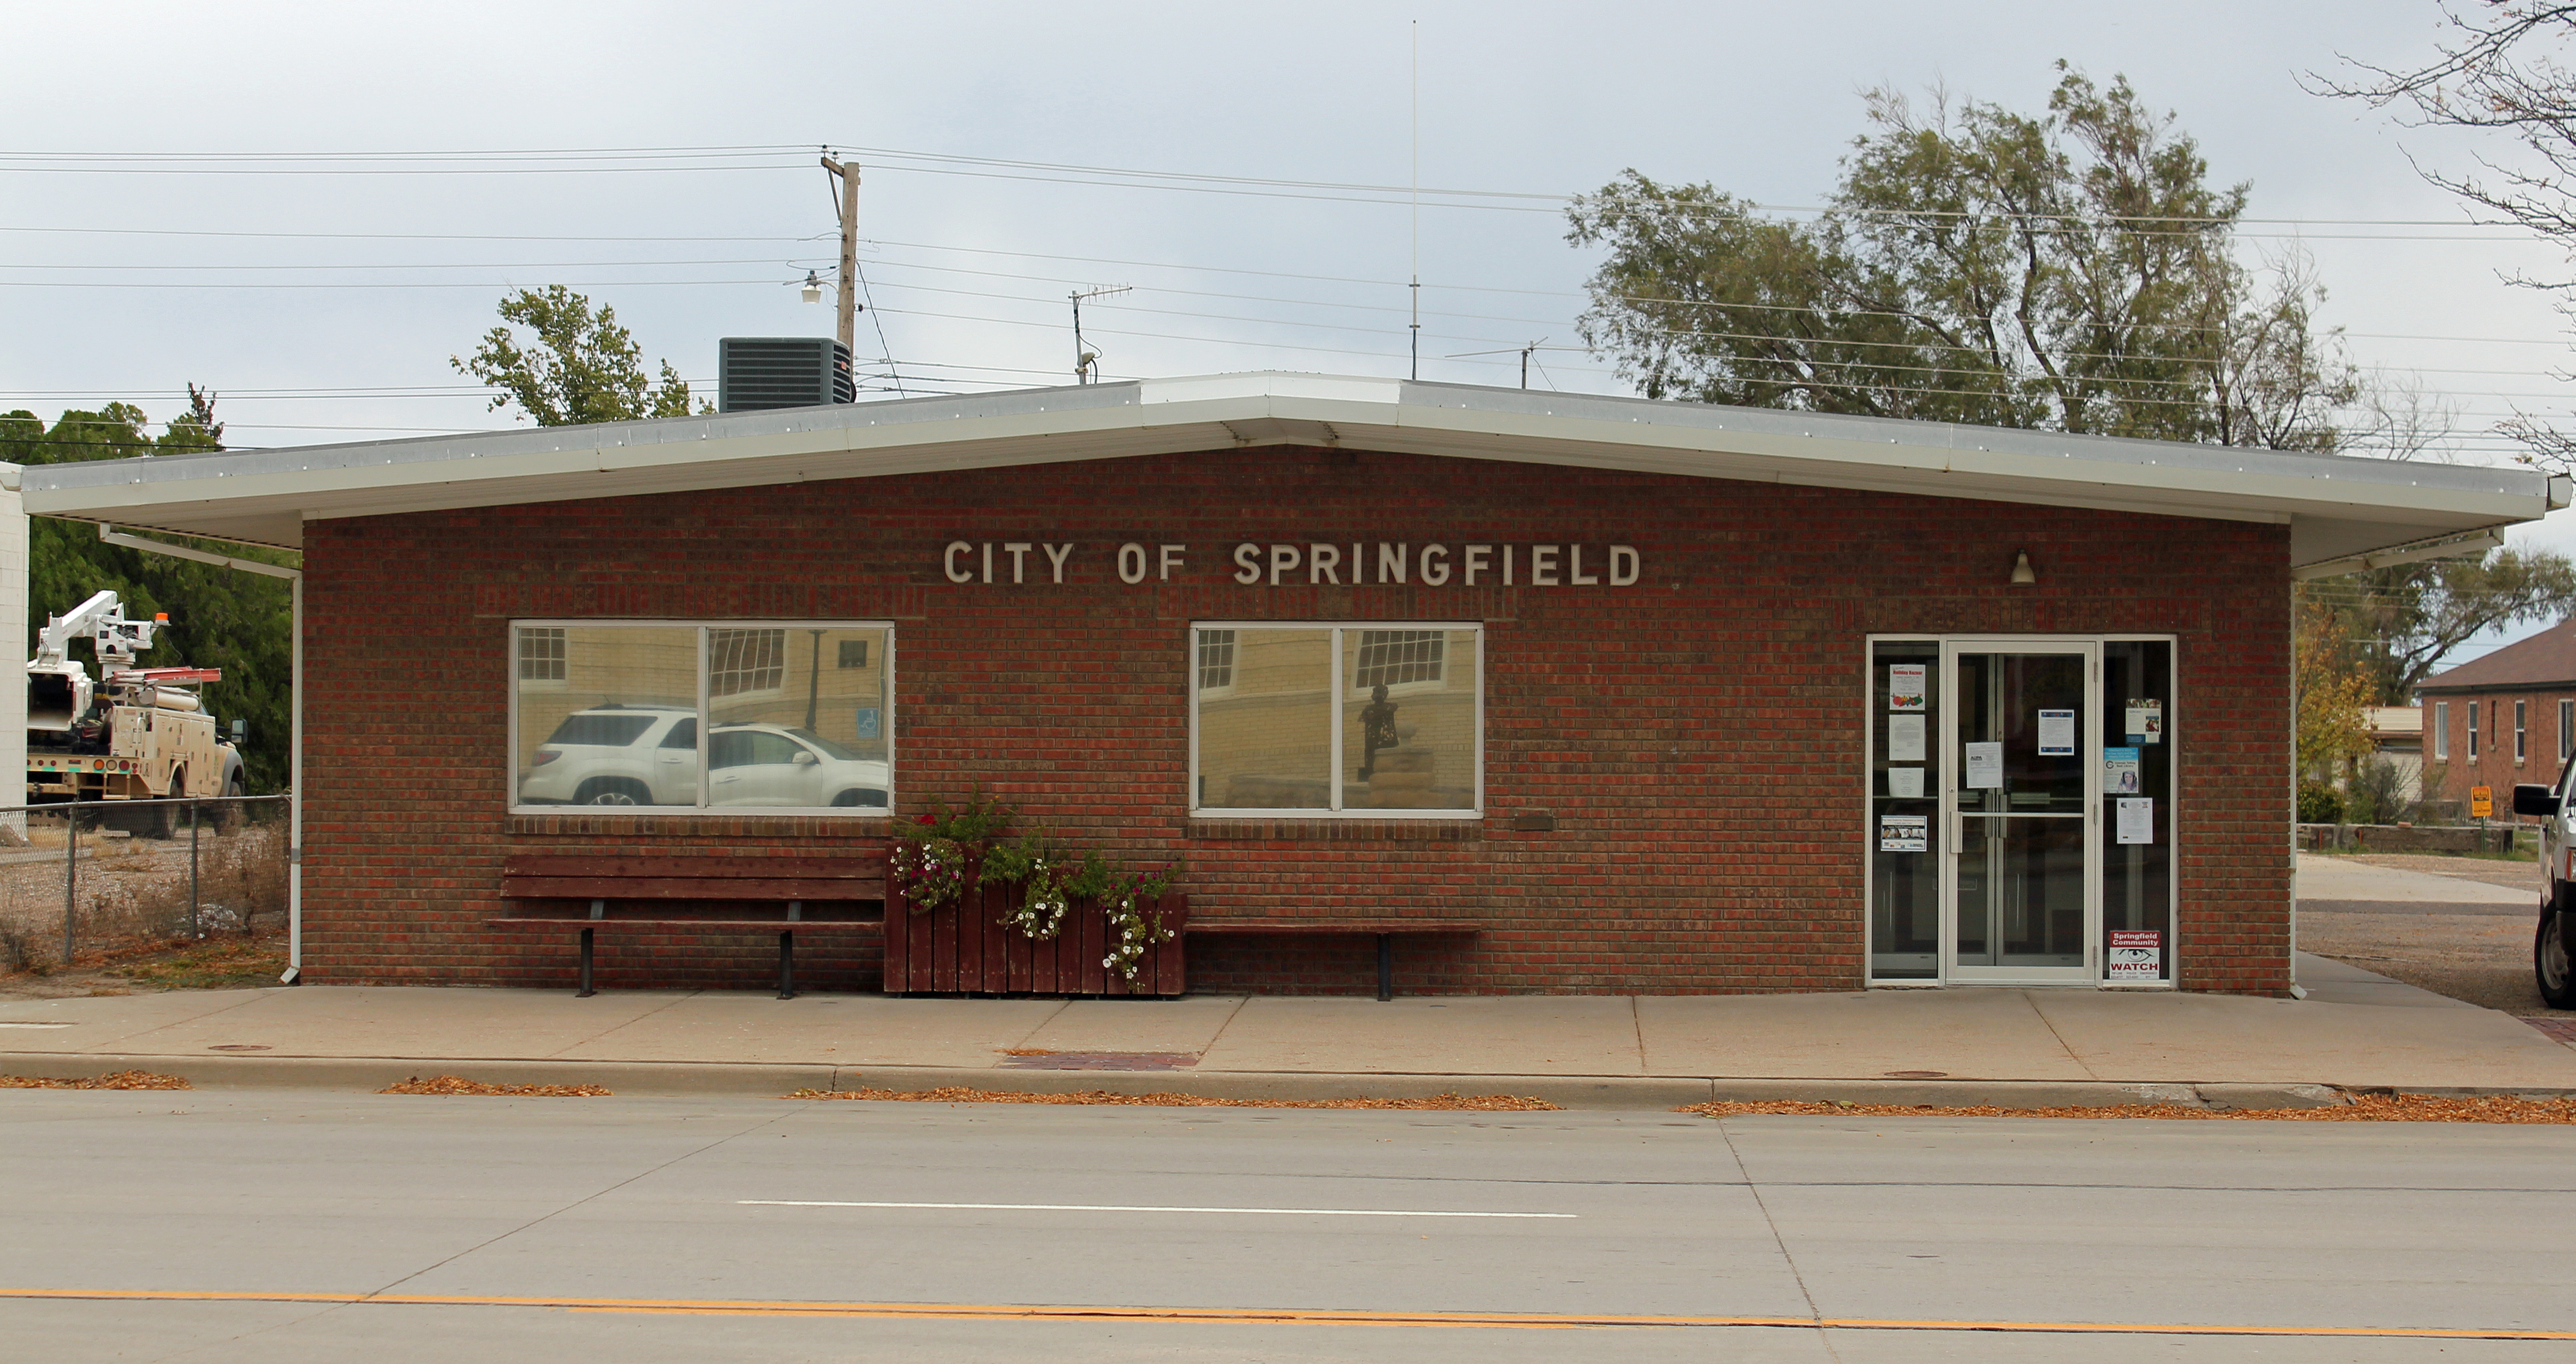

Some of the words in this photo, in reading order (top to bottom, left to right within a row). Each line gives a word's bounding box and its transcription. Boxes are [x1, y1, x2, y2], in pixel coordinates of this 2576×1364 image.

[944, 541, 1074, 584] CITY
[1117, 543, 1186, 585] OF
[1233, 543, 1641, 587] SPRINGFIELD
